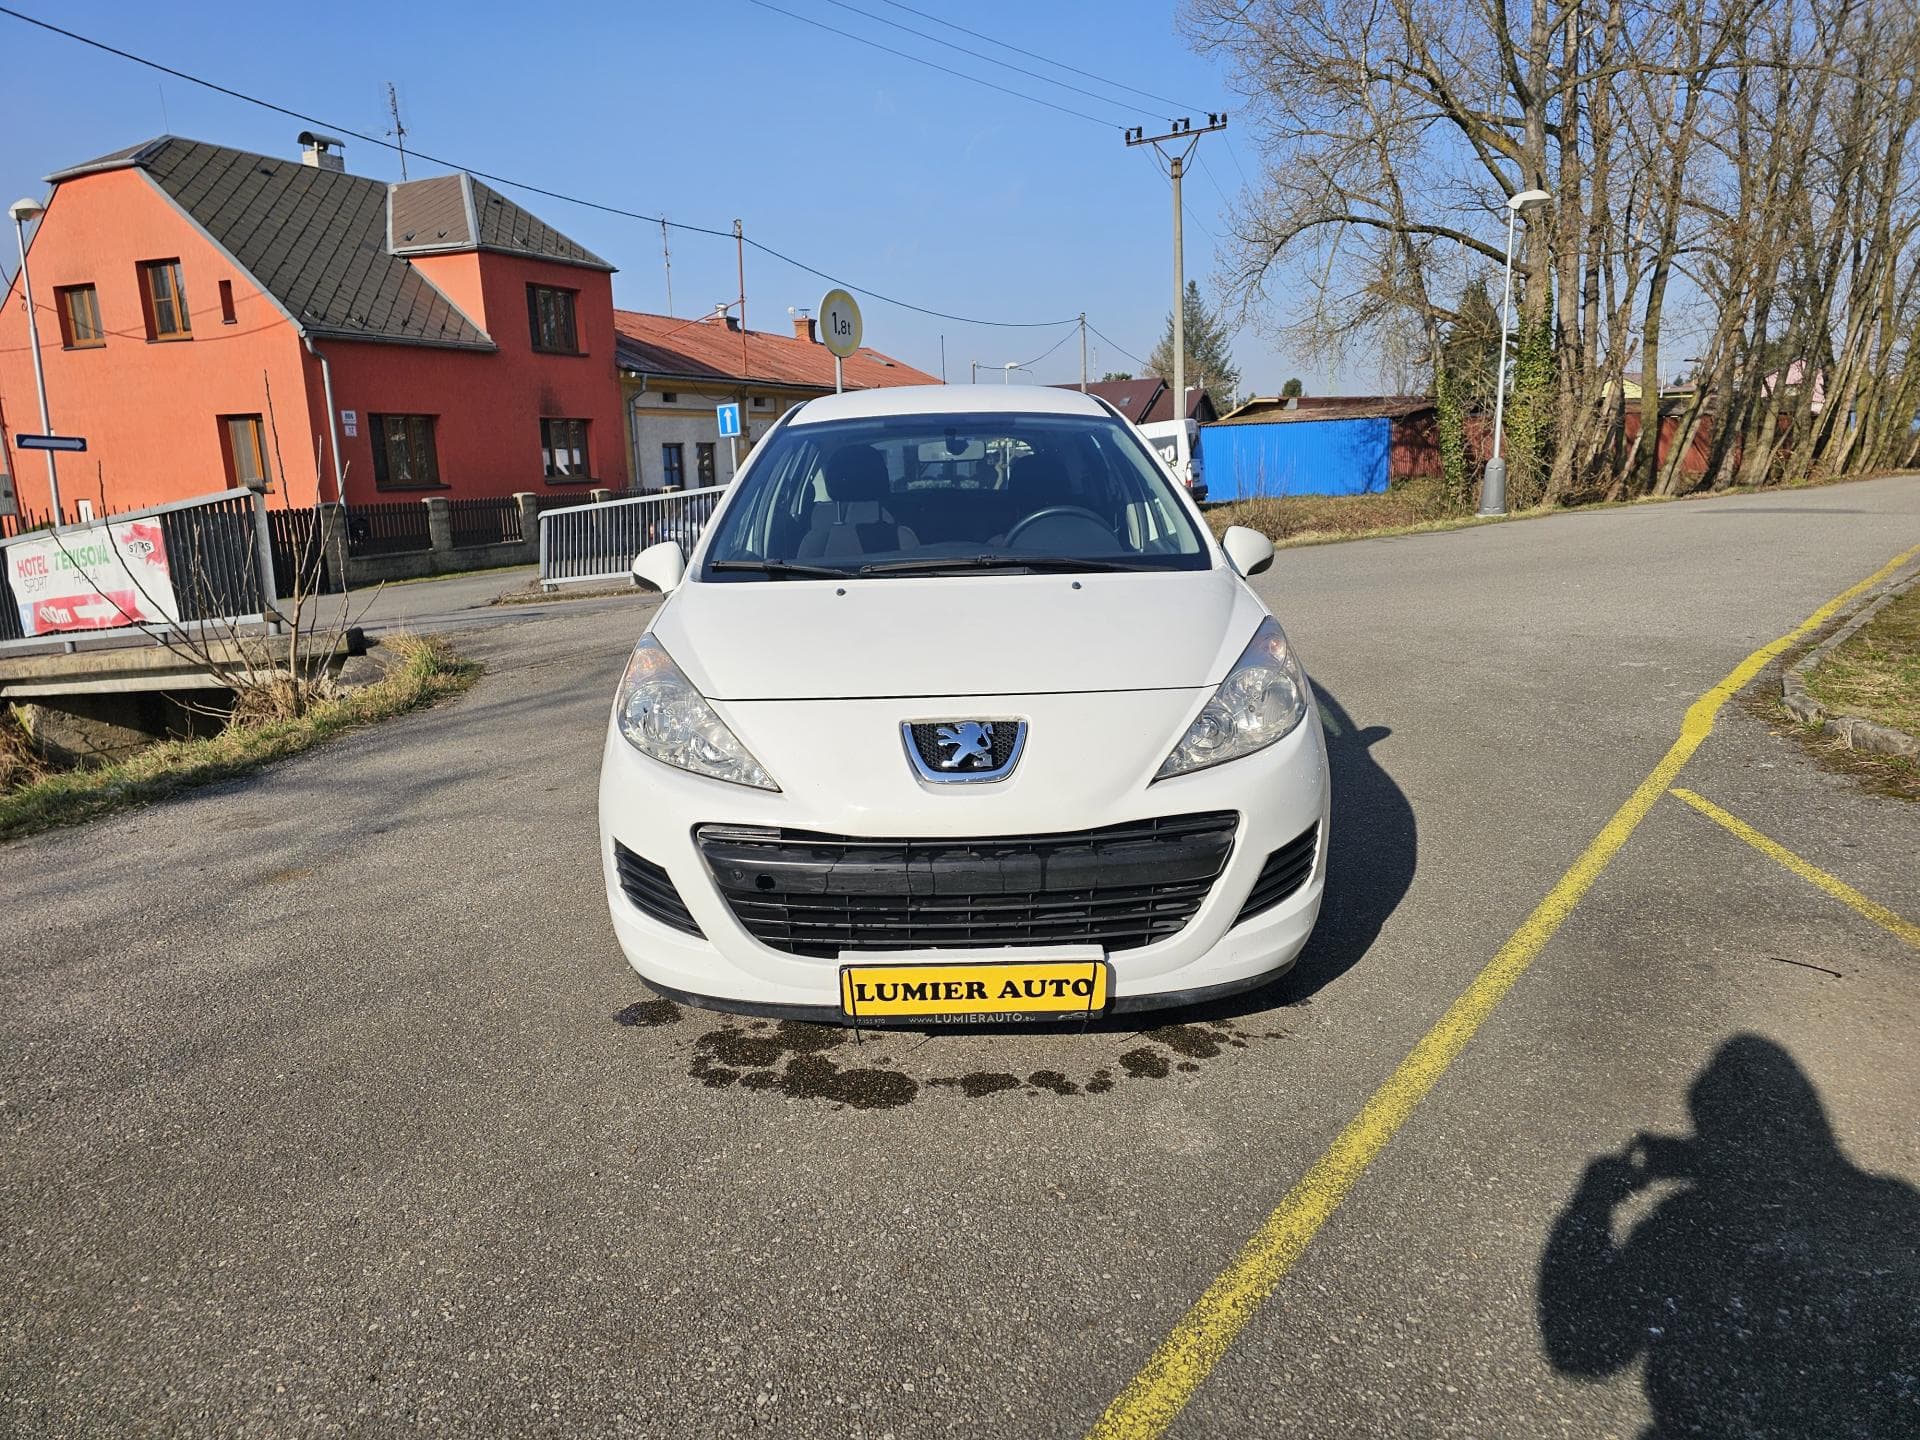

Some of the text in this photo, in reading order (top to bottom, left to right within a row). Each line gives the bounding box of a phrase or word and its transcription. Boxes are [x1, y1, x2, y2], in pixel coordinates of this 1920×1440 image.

[16, 555, 48, 578] HOTEL
[24, 568, 98, 593] SPORT HALA
[855, 978, 1095, 1002] LUMIER AUTO
[908, 1012, 1036, 1024] www.LUMIERAUTO.eu
